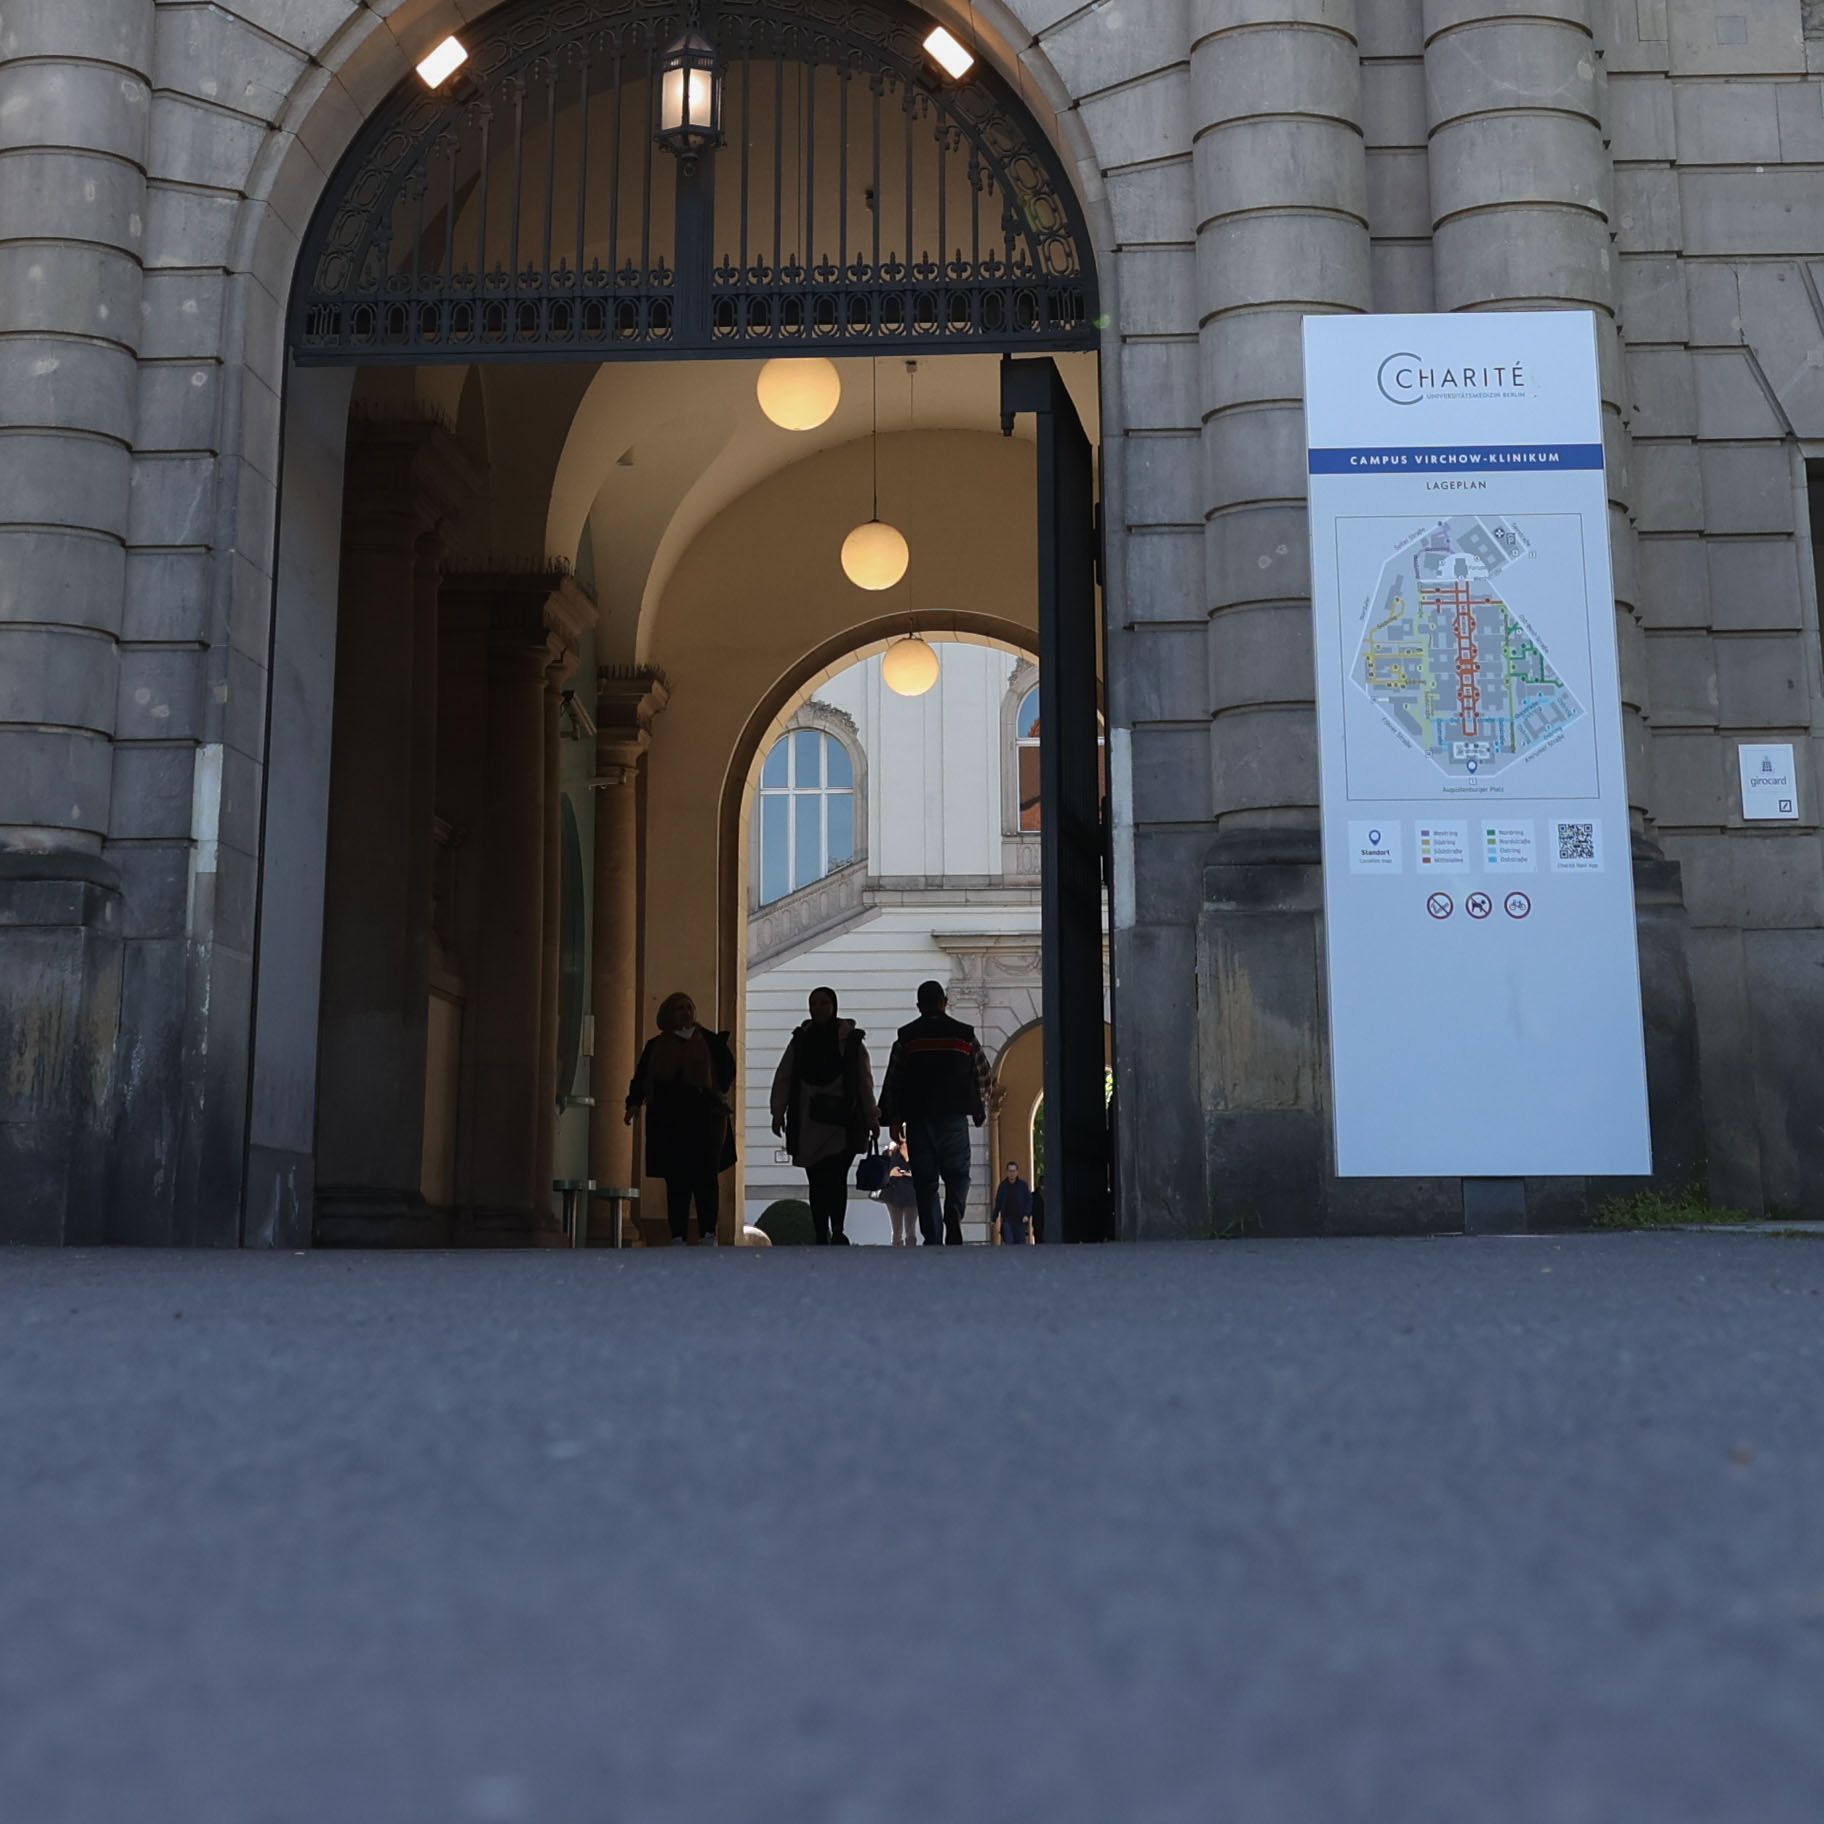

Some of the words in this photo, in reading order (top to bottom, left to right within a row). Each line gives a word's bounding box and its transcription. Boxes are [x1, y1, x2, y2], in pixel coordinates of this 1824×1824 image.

[1395, 361, 1525, 389] CHARITÉ
[1350, 454, 1408, 465] CAMPUS
[1415, 452, 1560, 464] VIRCHOW-KLINIKUM
[1426, 480, 1487, 490] LAGEPLAN
[1750, 776, 1787, 787] girocard
